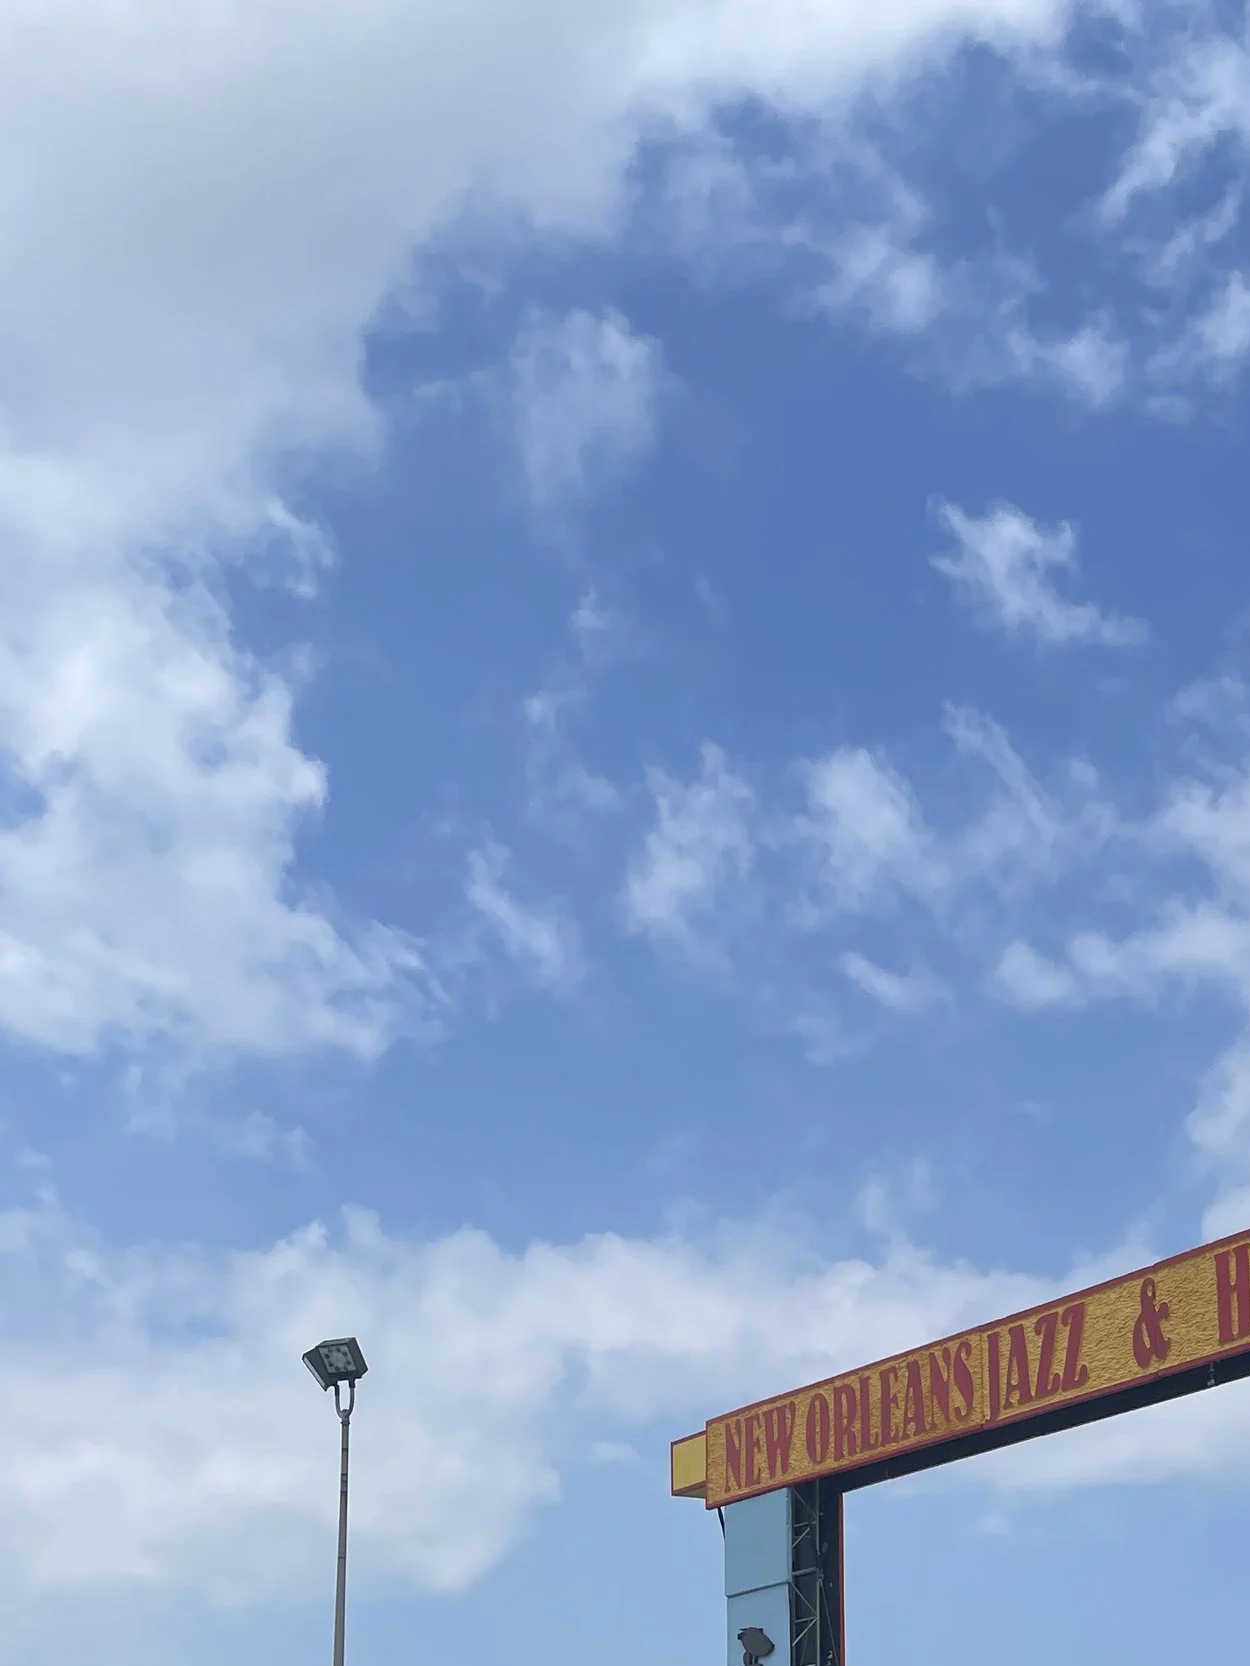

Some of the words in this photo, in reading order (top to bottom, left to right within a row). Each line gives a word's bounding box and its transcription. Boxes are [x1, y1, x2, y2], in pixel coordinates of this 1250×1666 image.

[723, 1401, 797, 1493] NEW
[805, 1341, 974, 1464] ORLEANS
[984, 1302, 1089, 1422] JAZZ
[1132, 1277, 1171, 1369] &
